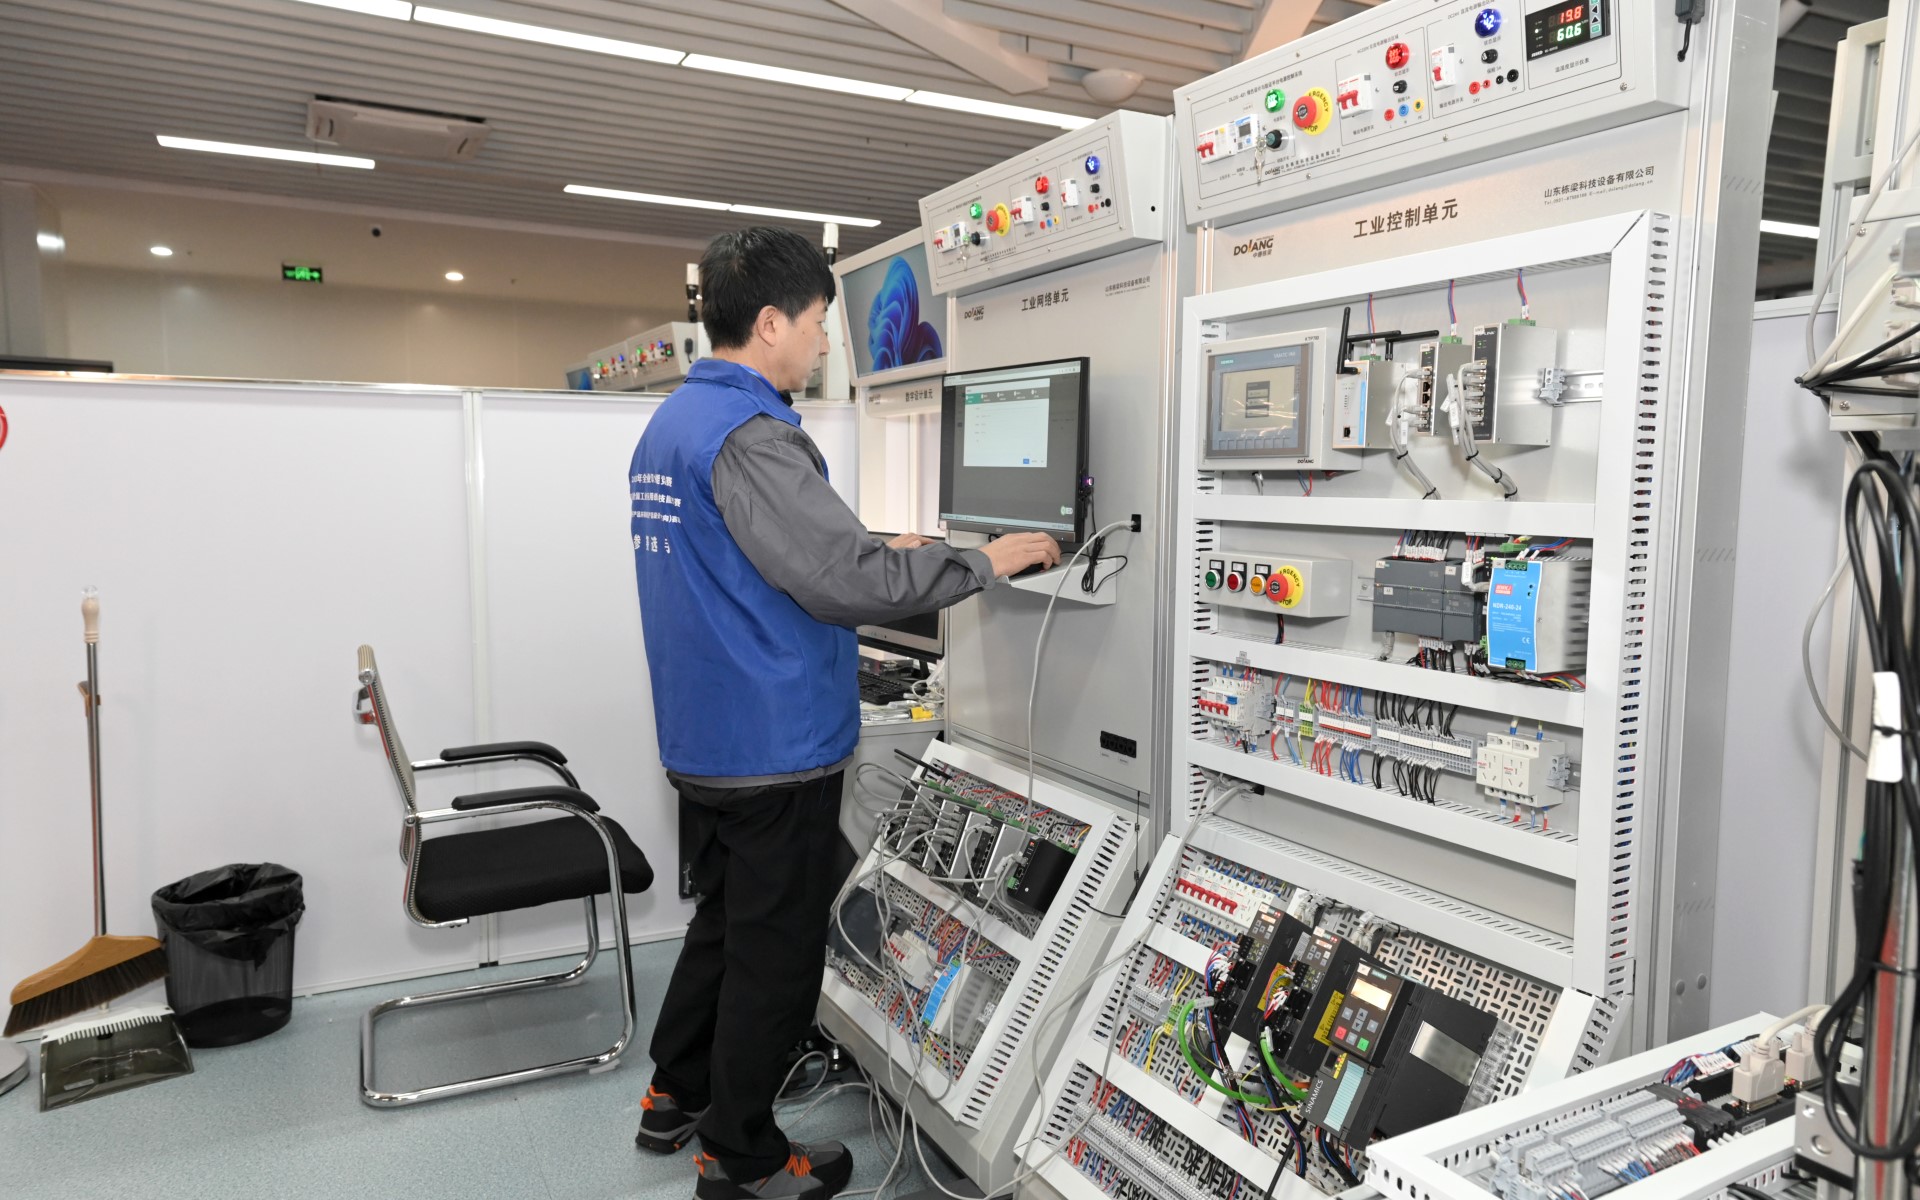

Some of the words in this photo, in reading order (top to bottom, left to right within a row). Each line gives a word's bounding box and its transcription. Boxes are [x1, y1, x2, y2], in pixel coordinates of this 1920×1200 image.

[1560, 6, 1582, 23] 19.8
[1557, 23, 1582, 41] 60.6
[1544, 165, 1655, 198] 山东栋梁科技设备有限公司
[1353, 198, 1458, 239] 工业控制单元
[1021, 288, 1069, 311] 工业网络单元
[1305, 1079, 1324, 1114] SINAMICS
